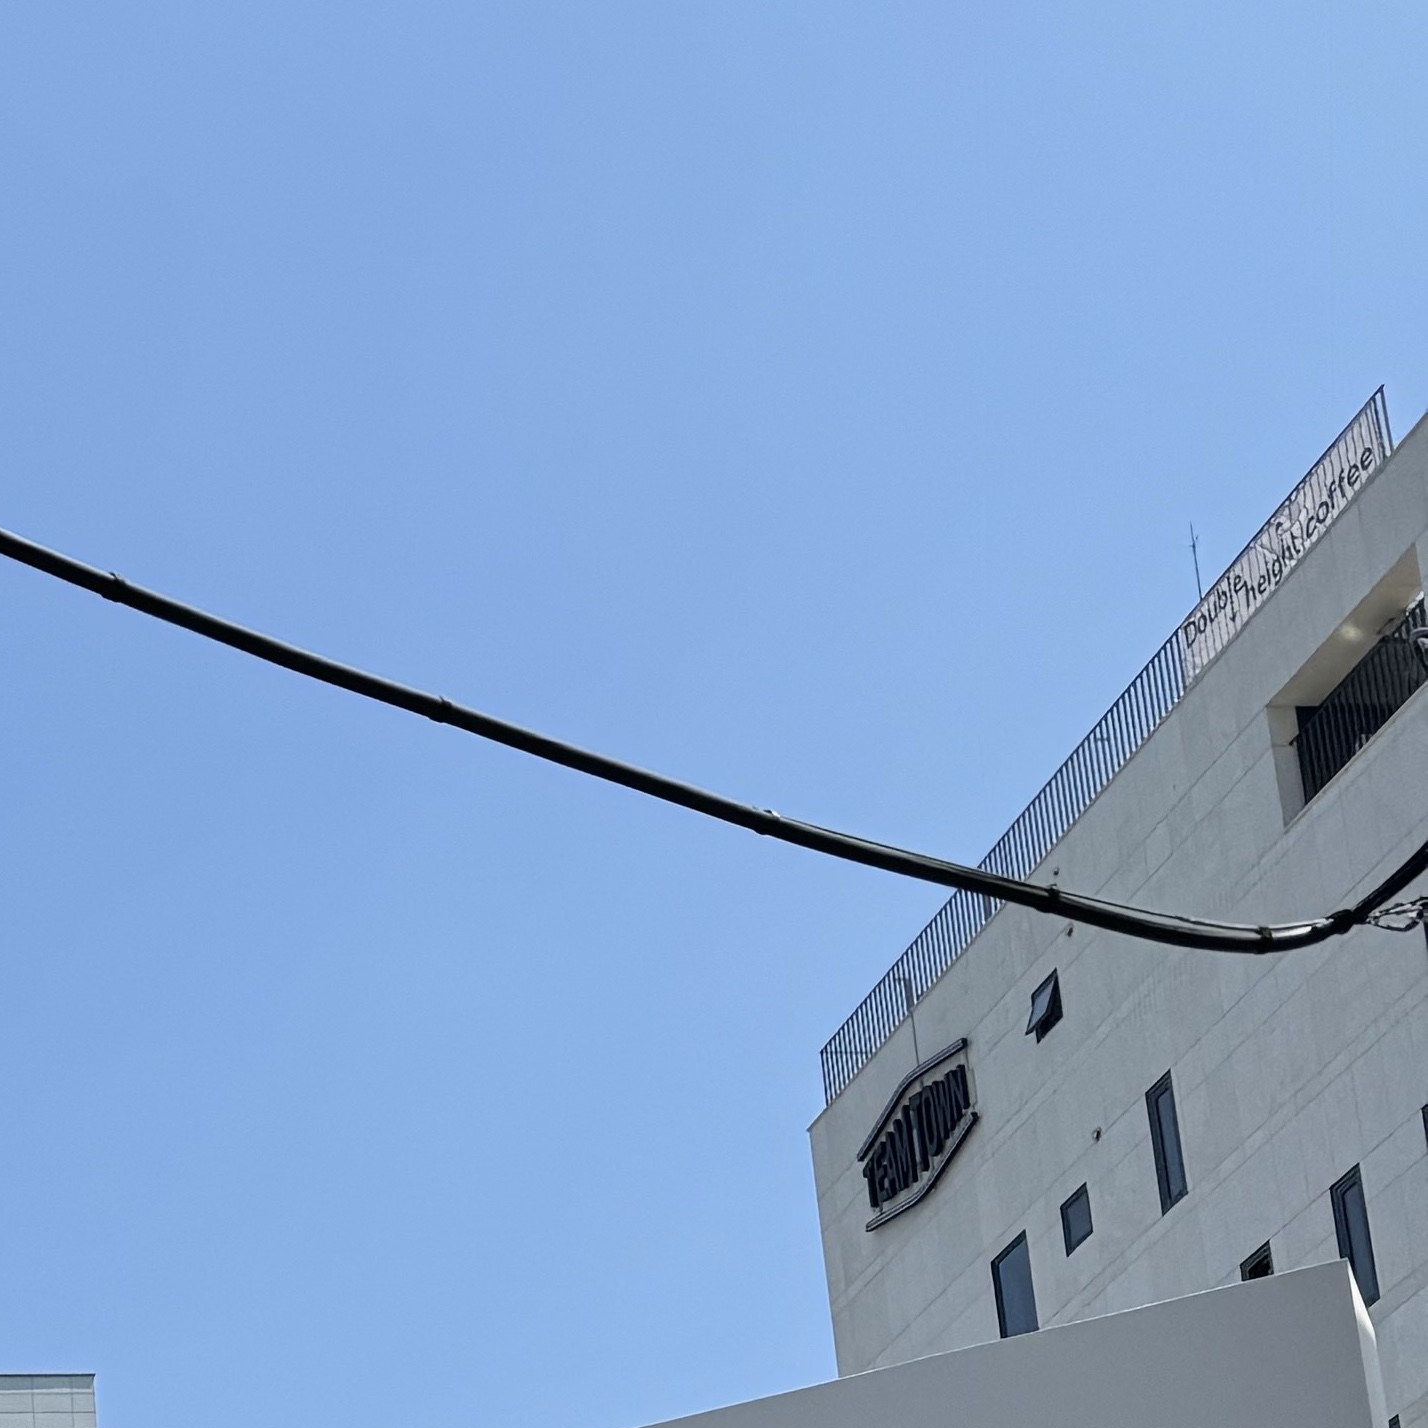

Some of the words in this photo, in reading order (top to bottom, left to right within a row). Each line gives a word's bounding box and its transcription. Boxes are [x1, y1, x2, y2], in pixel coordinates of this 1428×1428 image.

[1183, 573, 1245, 648] Double
[1244, 532, 1302, 610] height
[1305, 446, 1373, 540] coffee
[863, 1104, 918, 1208] TEAM
[909, 1064, 971, 1172] TOWN
